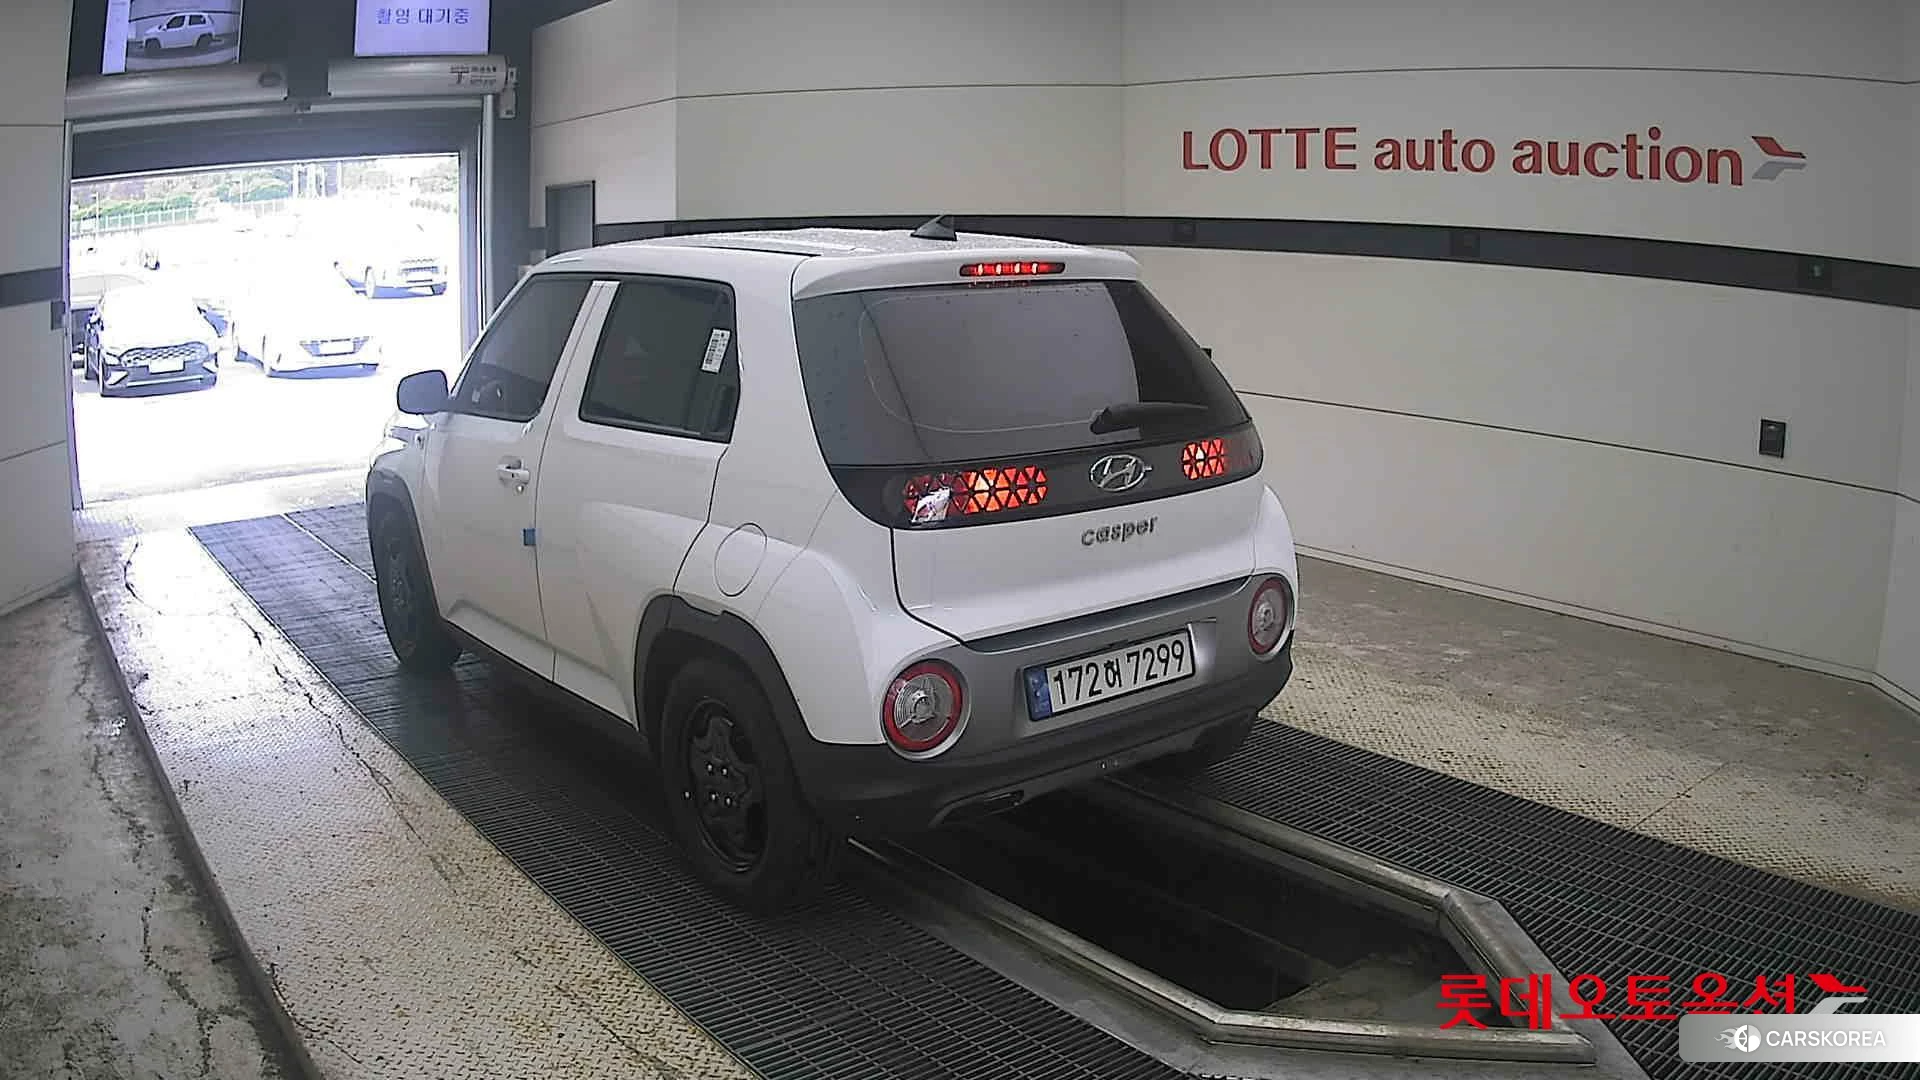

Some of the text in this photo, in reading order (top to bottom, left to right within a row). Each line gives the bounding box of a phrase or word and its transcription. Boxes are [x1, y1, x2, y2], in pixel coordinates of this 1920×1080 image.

[418, 8, 470, 25] 대기중
[1183, 126, 1743, 186] LOTTE auto auction
[1080, 516, 1158, 547] casper
[1126, 639, 1185, 685] 7299
